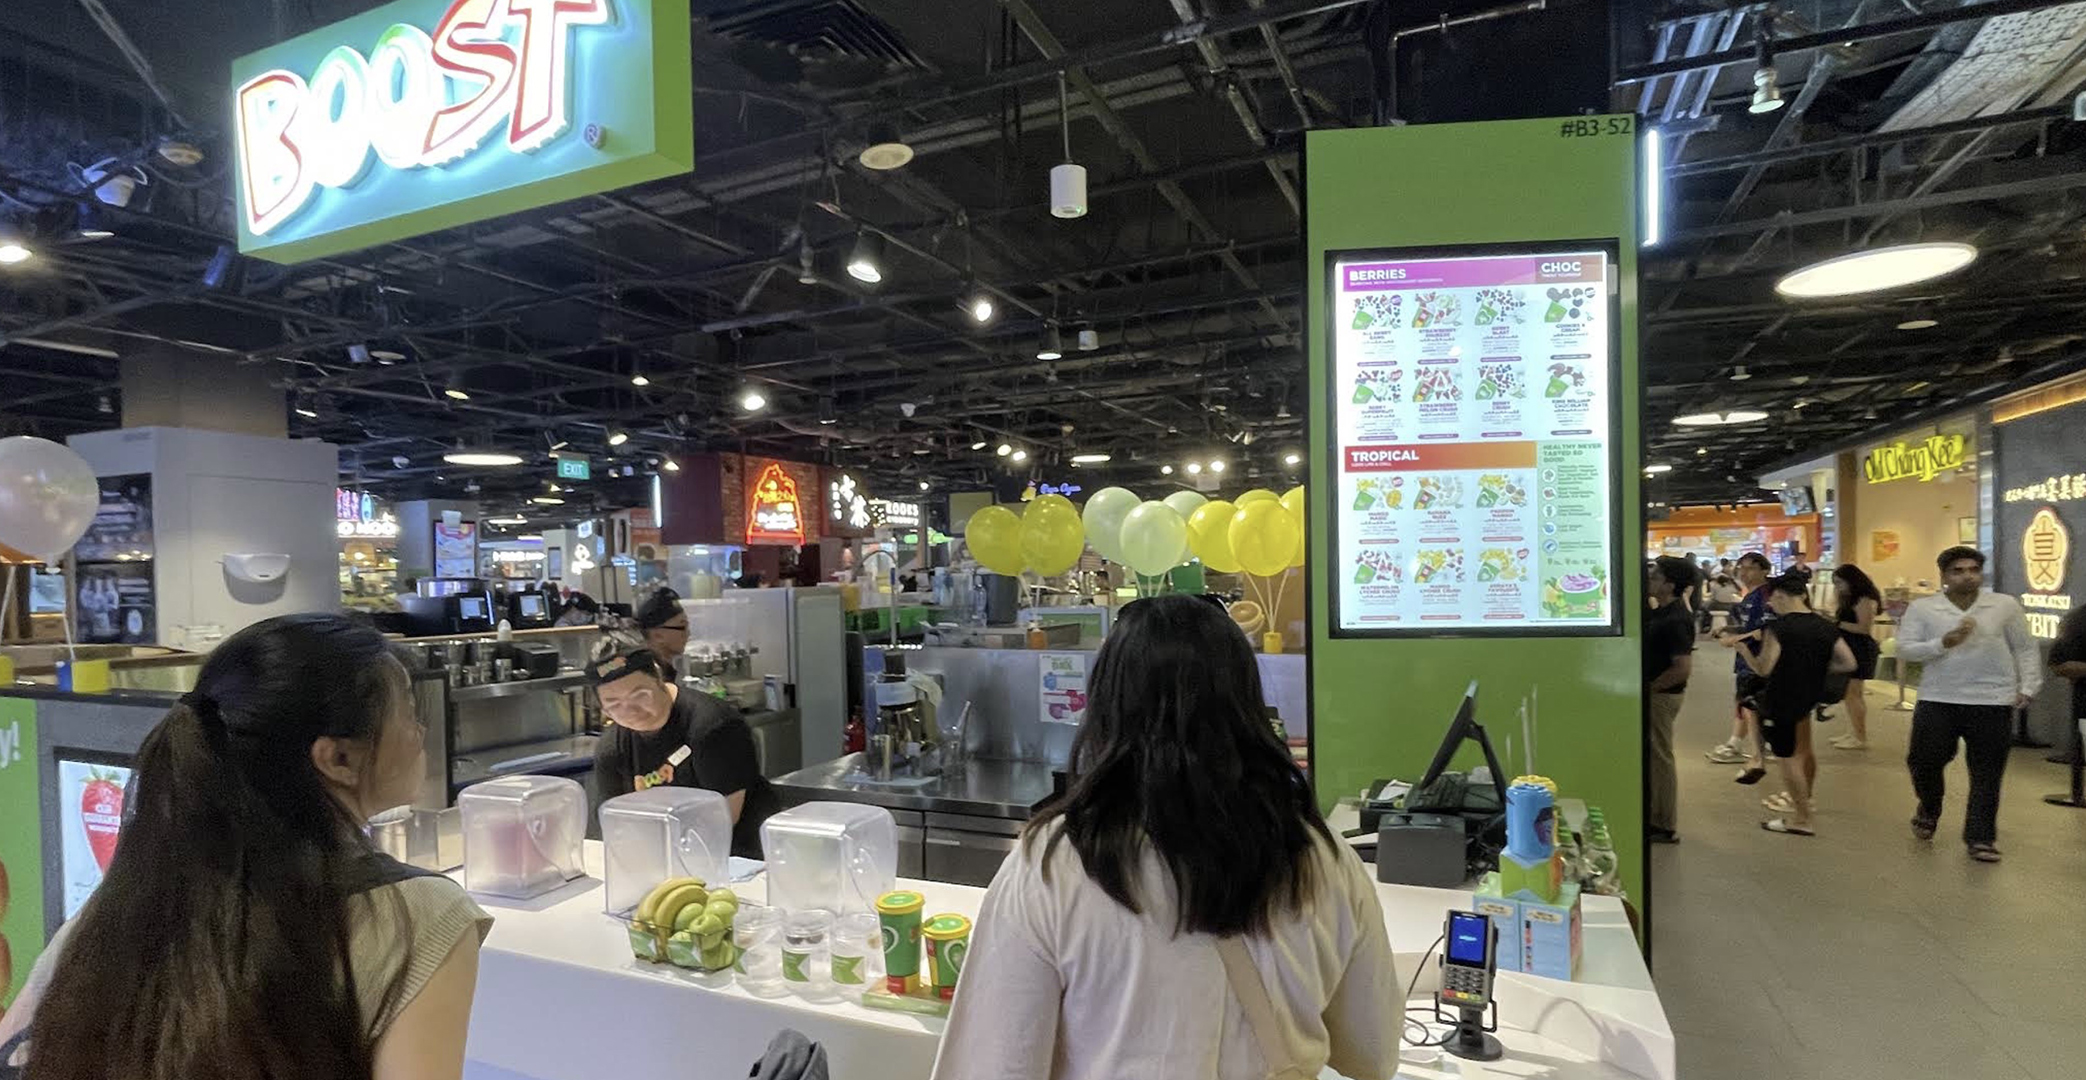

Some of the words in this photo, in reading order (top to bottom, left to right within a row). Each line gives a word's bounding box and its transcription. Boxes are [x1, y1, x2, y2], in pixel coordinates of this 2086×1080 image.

[236, 0, 609, 236] BOOST
[1561, 117, 1631, 138] #B3-52
[1541, 261, 1582, 273] CHOC
[1349, 268, 1407, 281] BERRIES
[1351, 450, 1419, 463] TROPICAL
[564, 462, 583, 475] EXIT
